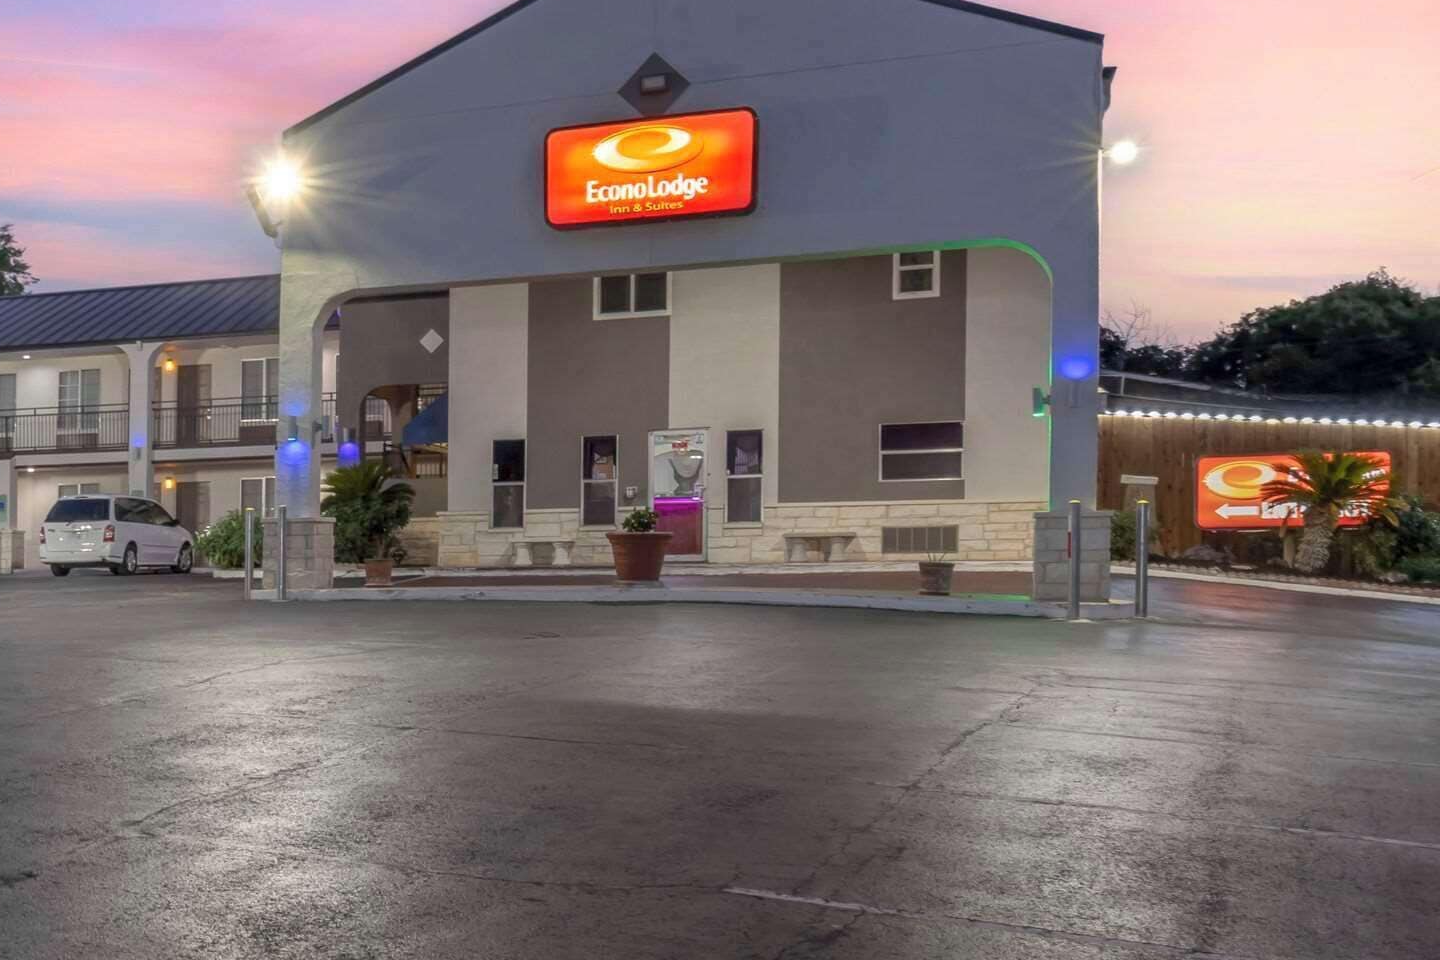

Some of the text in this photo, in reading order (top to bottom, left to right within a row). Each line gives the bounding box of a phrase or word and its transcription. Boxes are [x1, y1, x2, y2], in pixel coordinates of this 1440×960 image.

[585, 173, 709, 204] EconoLodge
[609, 200, 684, 215] Inn & Suites
